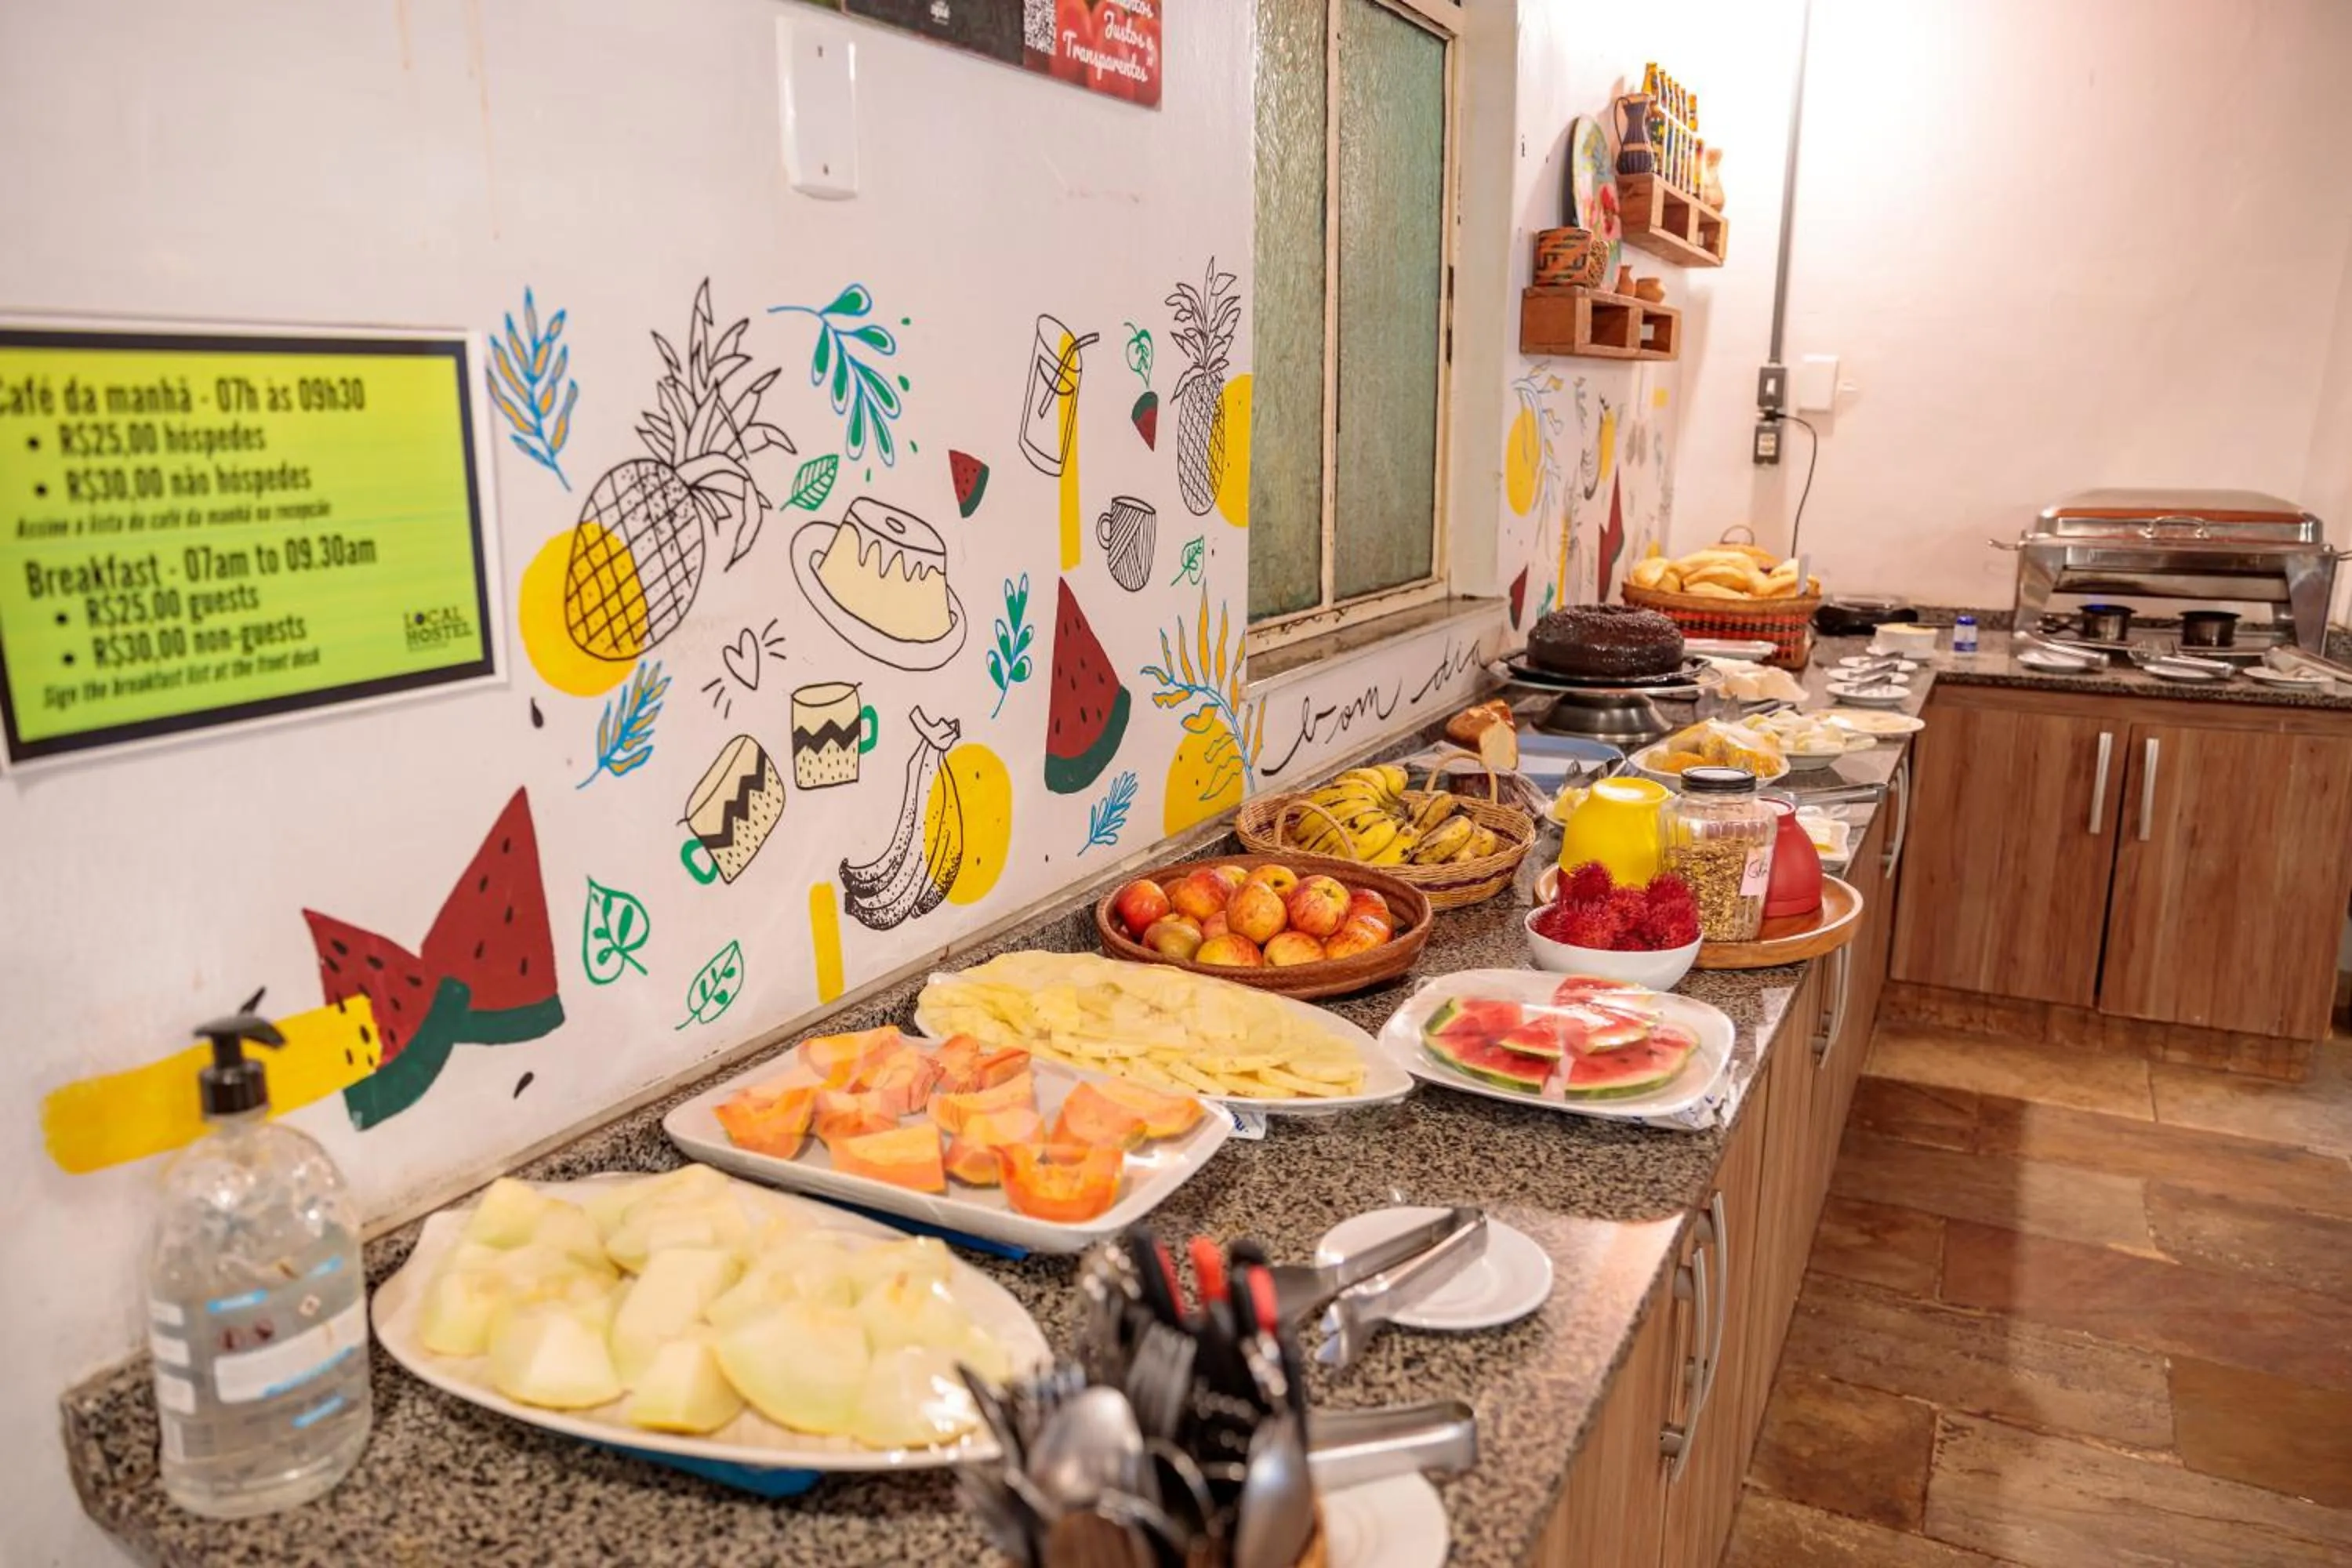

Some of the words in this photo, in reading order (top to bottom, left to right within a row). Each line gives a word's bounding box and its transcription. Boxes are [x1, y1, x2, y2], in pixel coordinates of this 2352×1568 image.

[1104, 9, 1145, 49] Justos
[64, 376, 97, 415] da
[105, 376, 191, 414] manhã
[216, 377, 259, 412] 07h
[299, 376, 365, 412] 09h30
[59, 423, 158, 459] R$25,00
[163, 420, 267, 459] hóspedes
[67, 467, 164, 505] R$30,00
[25, 553, 161, 600] Breakfast
[184, 547, 249, 583] 07am
[256, 544, 279, 575] to
[285, 535, 376, 572] 09.30am
[189, 584, 260, 624] guests
[404, 606, 463, 630] LOCAL
[194, 615, 307, 655] non-guests
[406, 621, 473, 645] HOSTEL
[1261, 676, 1403, 776] bom
[1410, 634, 1491, 704] dia
